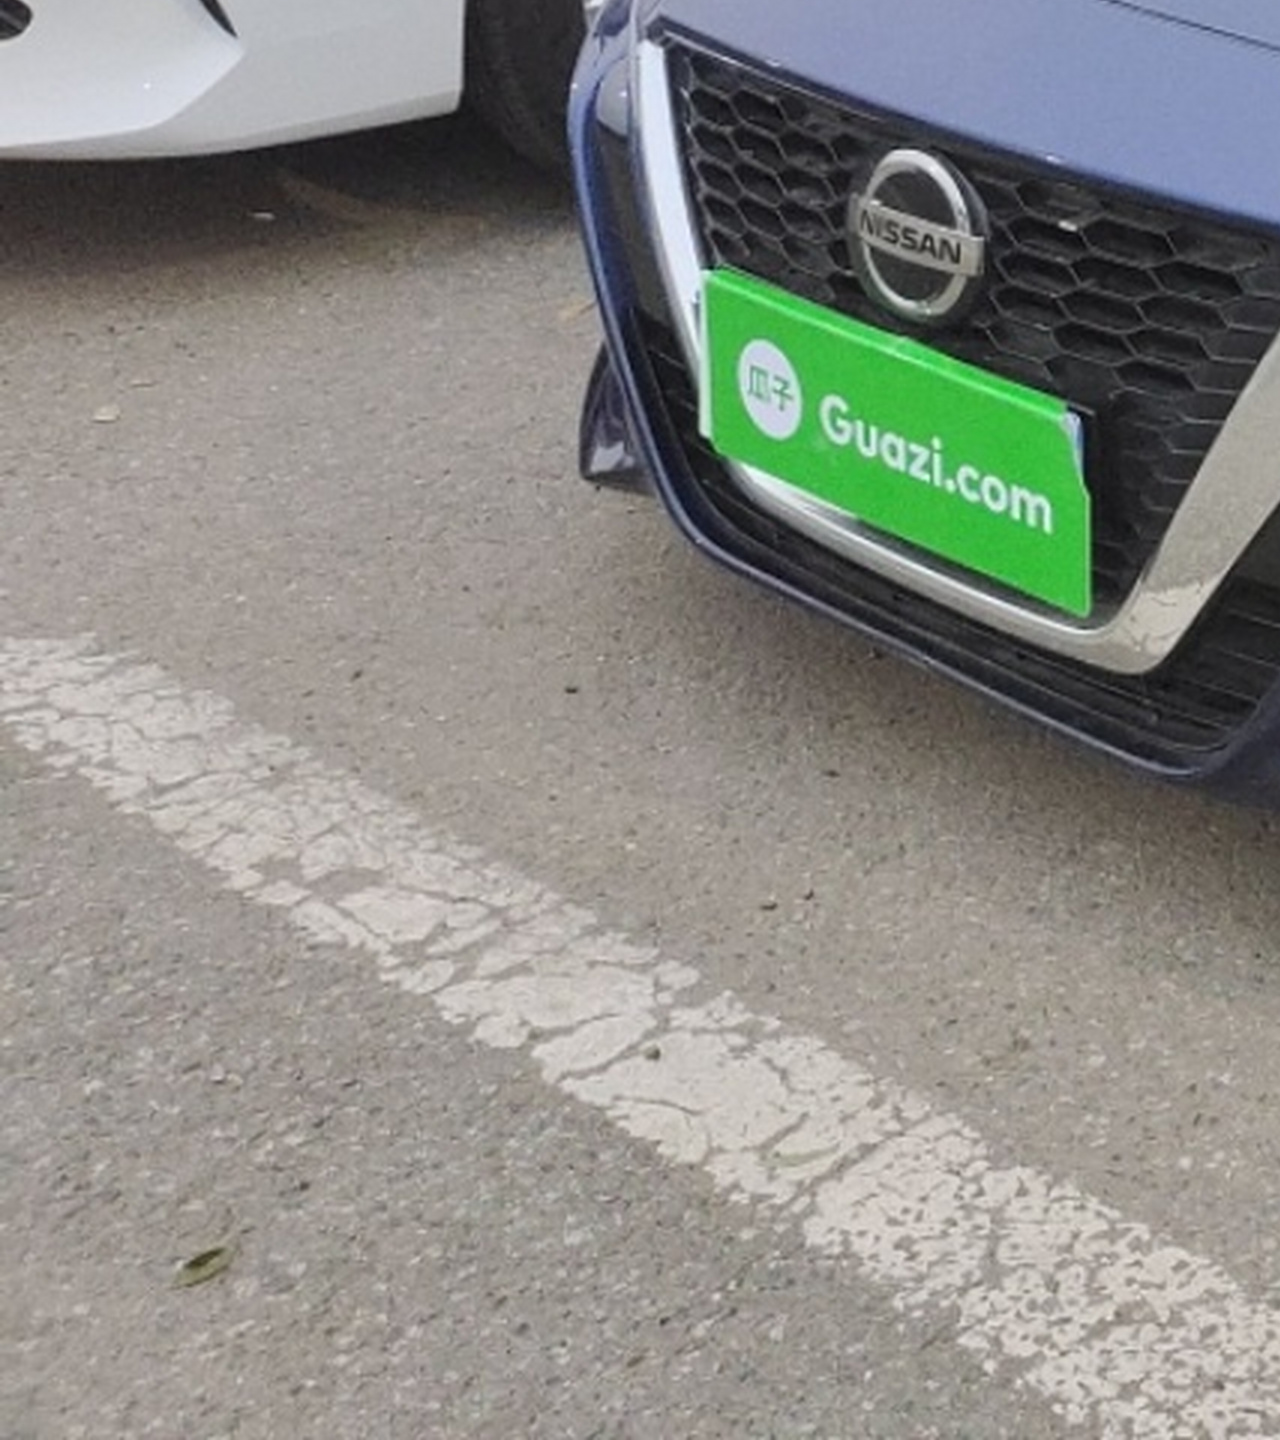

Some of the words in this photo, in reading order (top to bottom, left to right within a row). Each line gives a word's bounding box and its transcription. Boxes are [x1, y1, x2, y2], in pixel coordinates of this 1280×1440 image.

[860, 208, 962, 265] NISSAN
[749, 365, 794, 413] 瓜子
[818, 393, 1054, 534] Guazi.com
